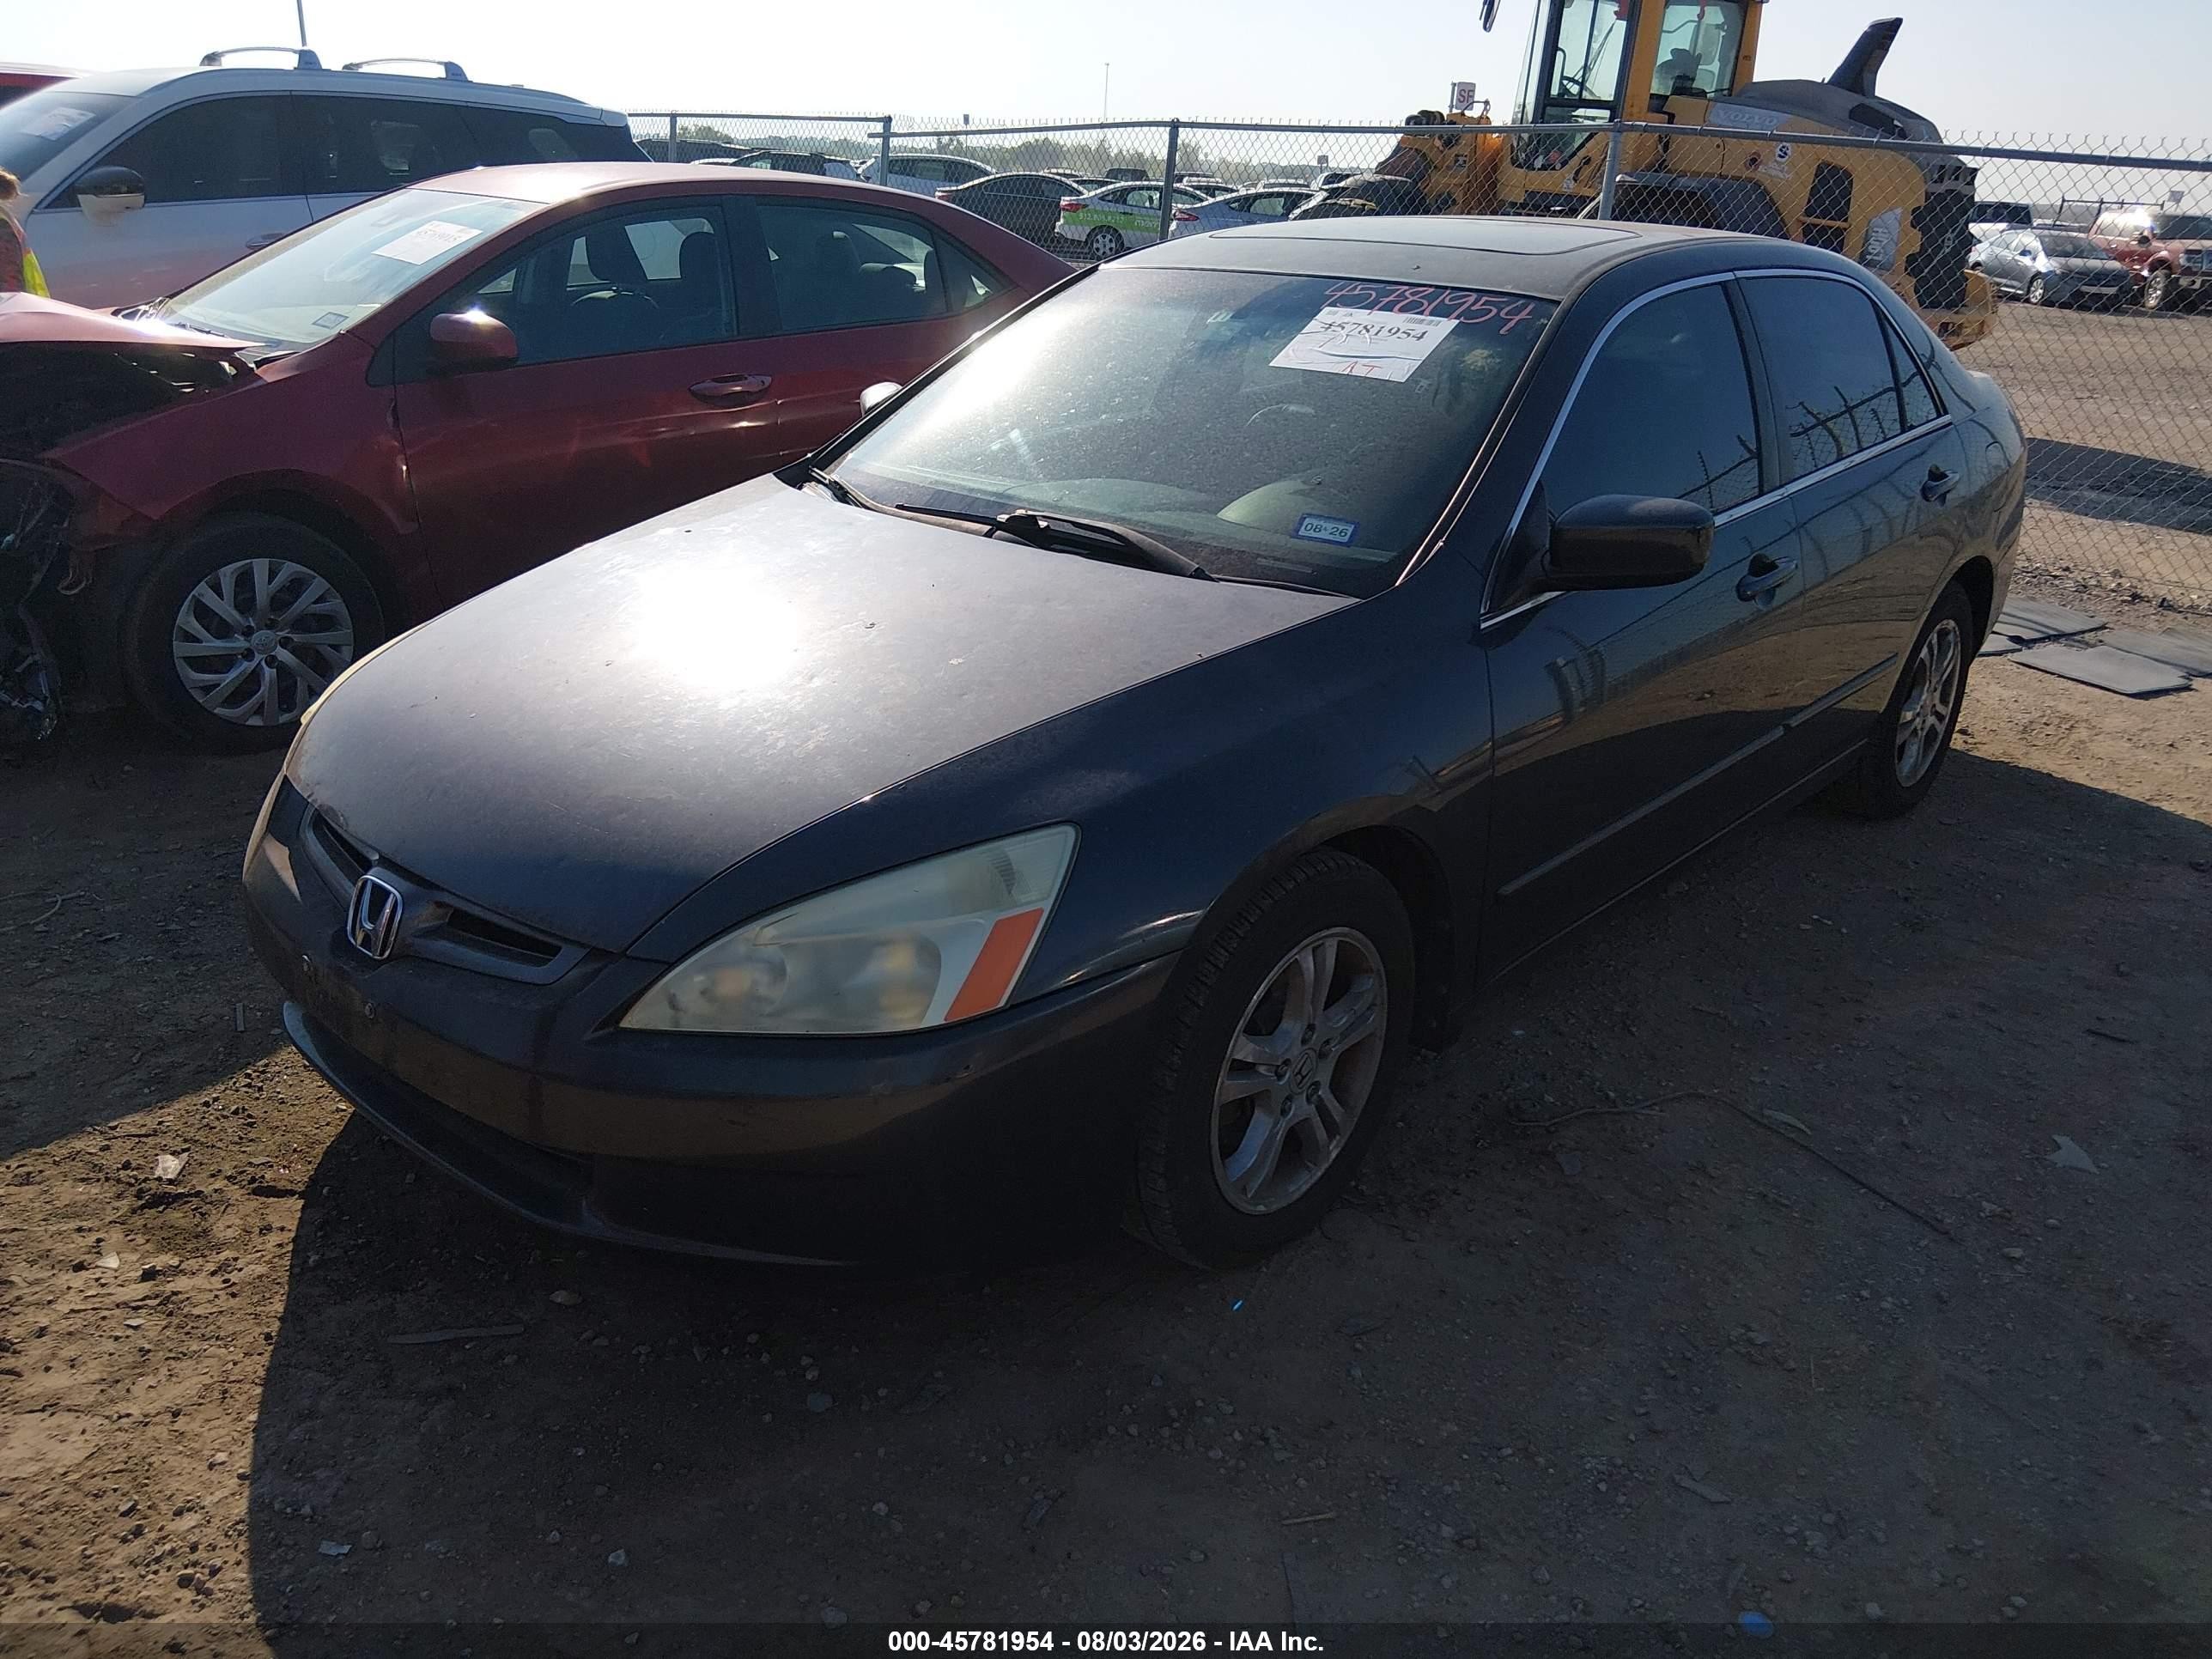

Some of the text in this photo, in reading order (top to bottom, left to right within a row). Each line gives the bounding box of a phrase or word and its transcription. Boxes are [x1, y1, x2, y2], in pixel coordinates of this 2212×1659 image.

[1457, 88, 1474, 104] SF
[1718, 108, 1778, 126] VOLVO
[1320, 281, 1535, 335] 45781954
[1319, 320, 1428, 343] 45781954
